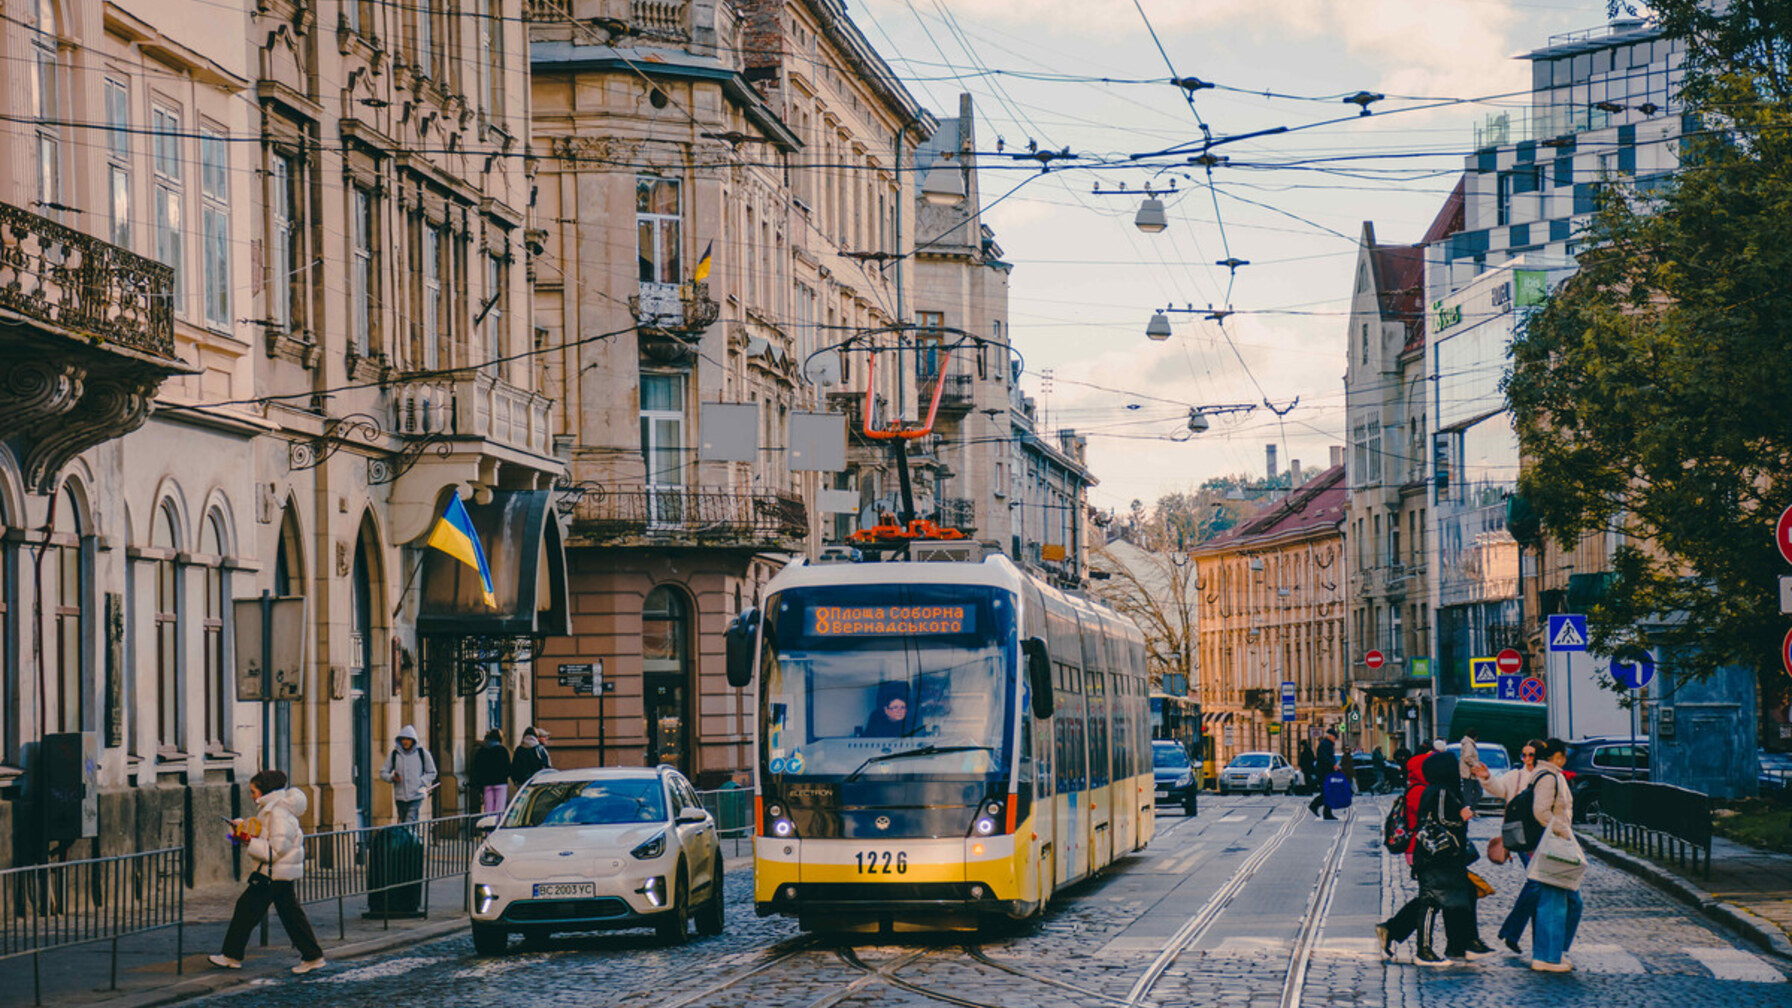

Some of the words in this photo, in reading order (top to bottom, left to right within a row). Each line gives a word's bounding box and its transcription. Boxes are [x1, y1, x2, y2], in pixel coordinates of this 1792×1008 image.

[1523, 277, 1541, 288] ibis
[830, 607, 885, 620] Площа
[889, 606, 964, 619] Соборна
[815, 607, 829, 634] 8
[832, 620, 962, 634] Вернадського
[855, 850, 907, 875] 1226
[539, 885, 553, 896] BC
[555, 884, 578, 895] 2003
[579, 884, 592, 895] YC
